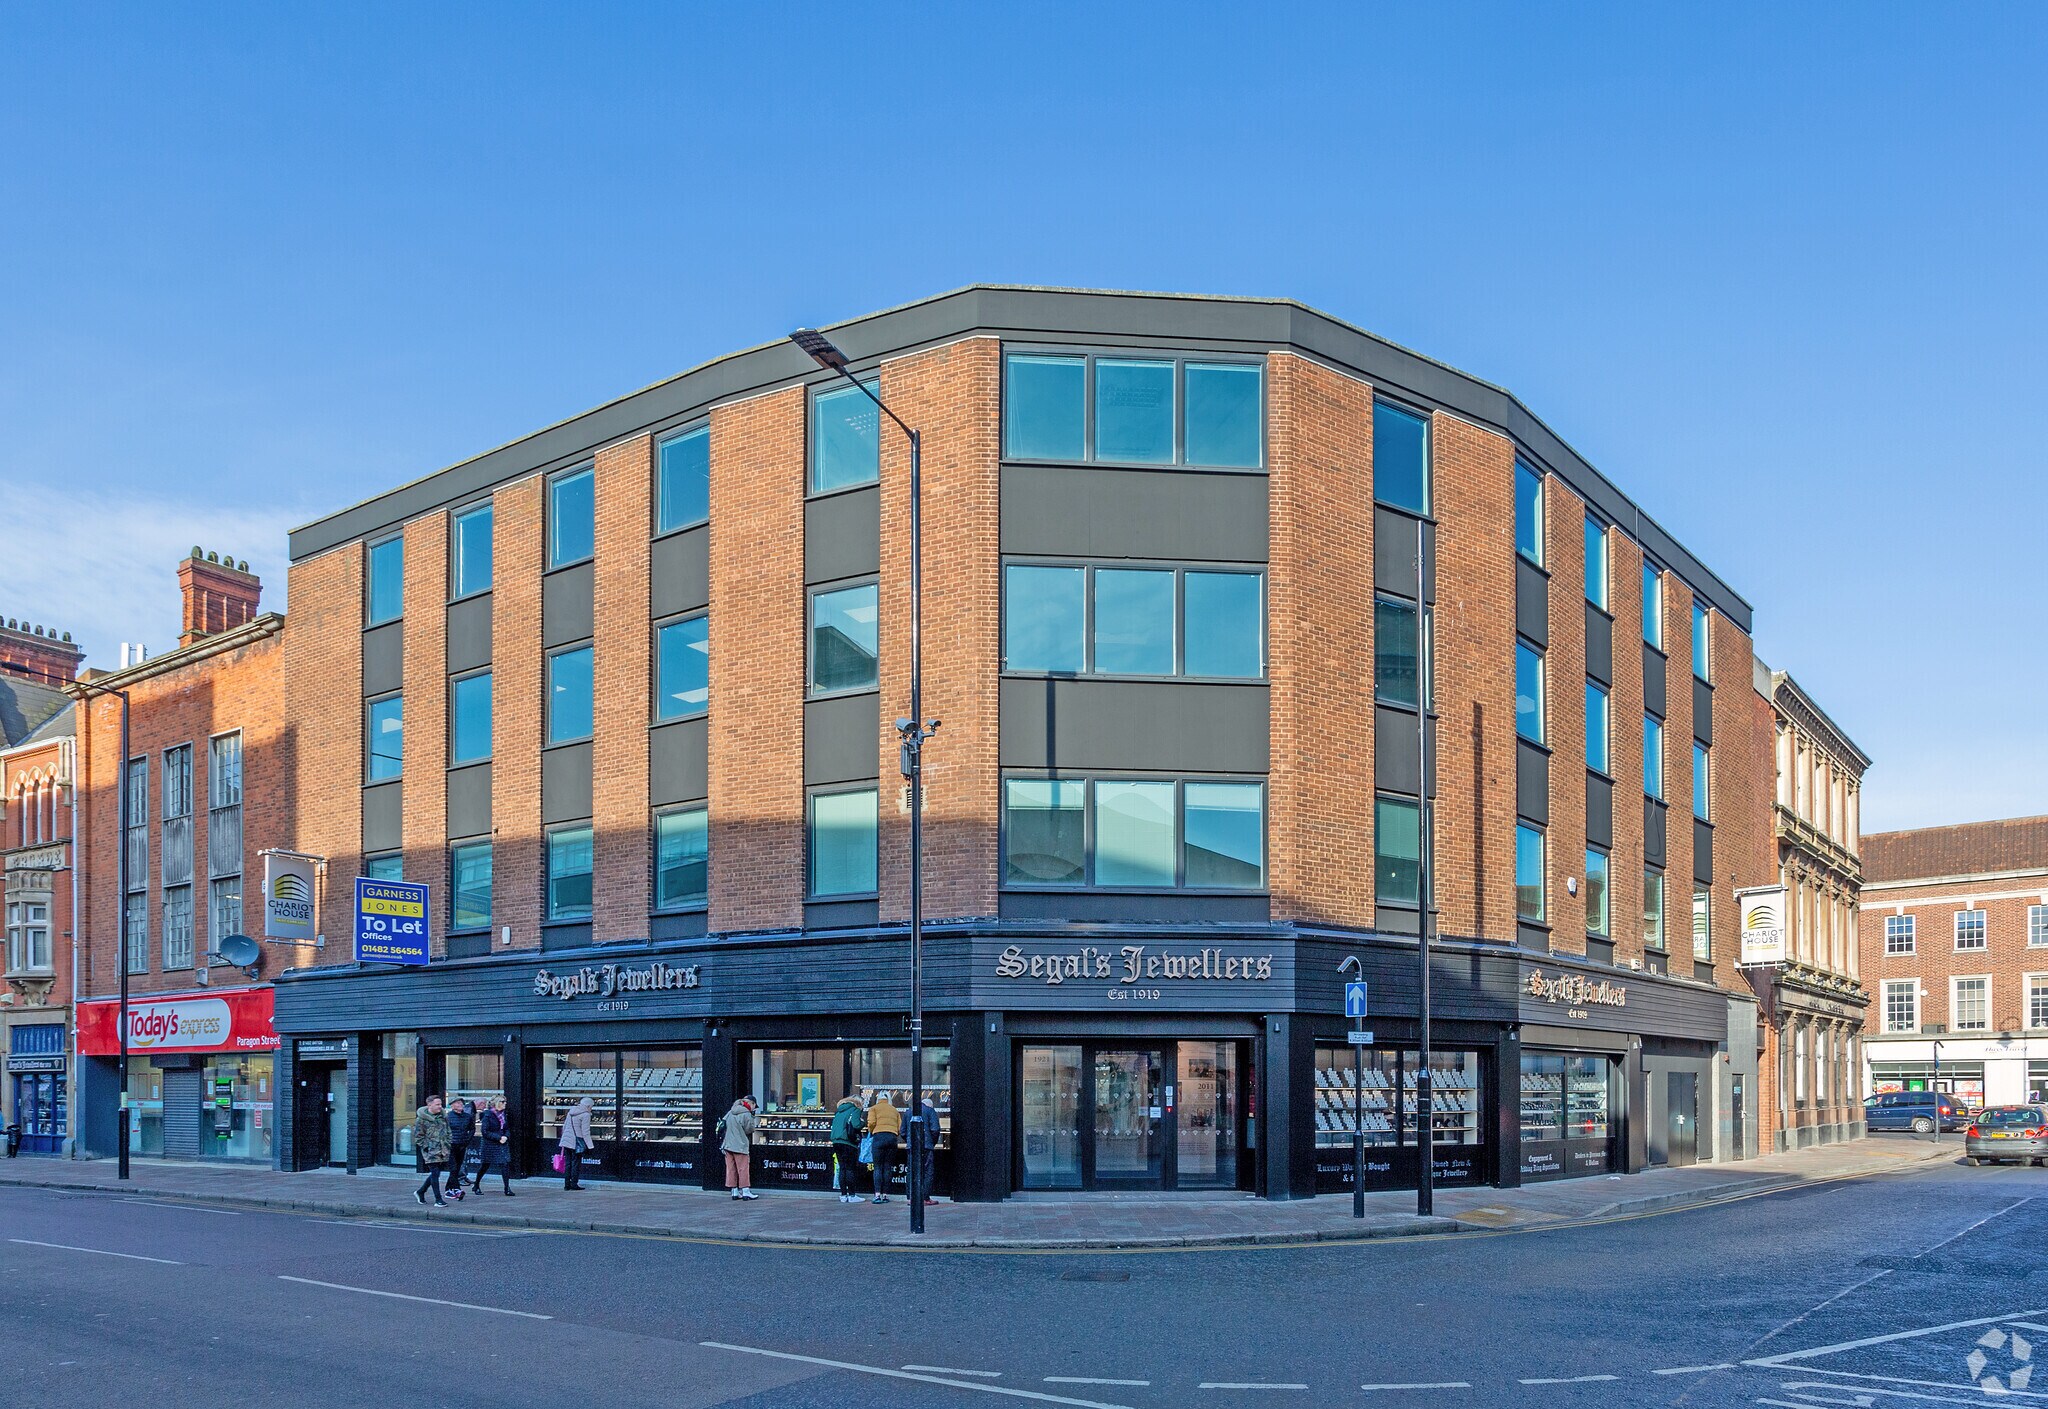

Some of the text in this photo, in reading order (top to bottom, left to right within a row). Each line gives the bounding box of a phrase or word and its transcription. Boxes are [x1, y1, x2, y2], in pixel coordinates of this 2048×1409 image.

[367, 888, 418, 900] GARNESS
[268, 900, 315, 912] CHARIOT
[367, 902, 418, 914] JONES
[274, 908, 310, 919] HOUSE
[362, 916, 423, 935] To Let
[362, 932, 392, 941] Offices
[1742, 928, 1784, 938] CHARIOT
[1747, 936, 1778, 945] HOUSE
[362, 945, 422, 955] 01482 564564
[996, 945, 1273, 984] Segal's Jewellers
[533, 962, 700, 1000] Segal's Jewellers
[1107, 988, 1160, 1000] Est 1919
[1573, 975, 1625, 1007] Jewellers
[611, 1001, 629, 1011] 1919
[128, 1008, 220, 1042] Today's express
[237, 1036, 260, 1047] Paragon
[665, 1161, 693, 1169] Diamonds
[763, 1159, 827, 1171] Jewellery & Watch
[1368, 1162, 1390, 1171] Bought
[1451, 1159, 1465, 1168] New
[1466, 1159, 1472, 1167] &
[781, 1170, 808, 1180] Repairs
[1343, 1173, 1349, 1182] &
[1443, 1169, 1468, 1178] Jewellery
